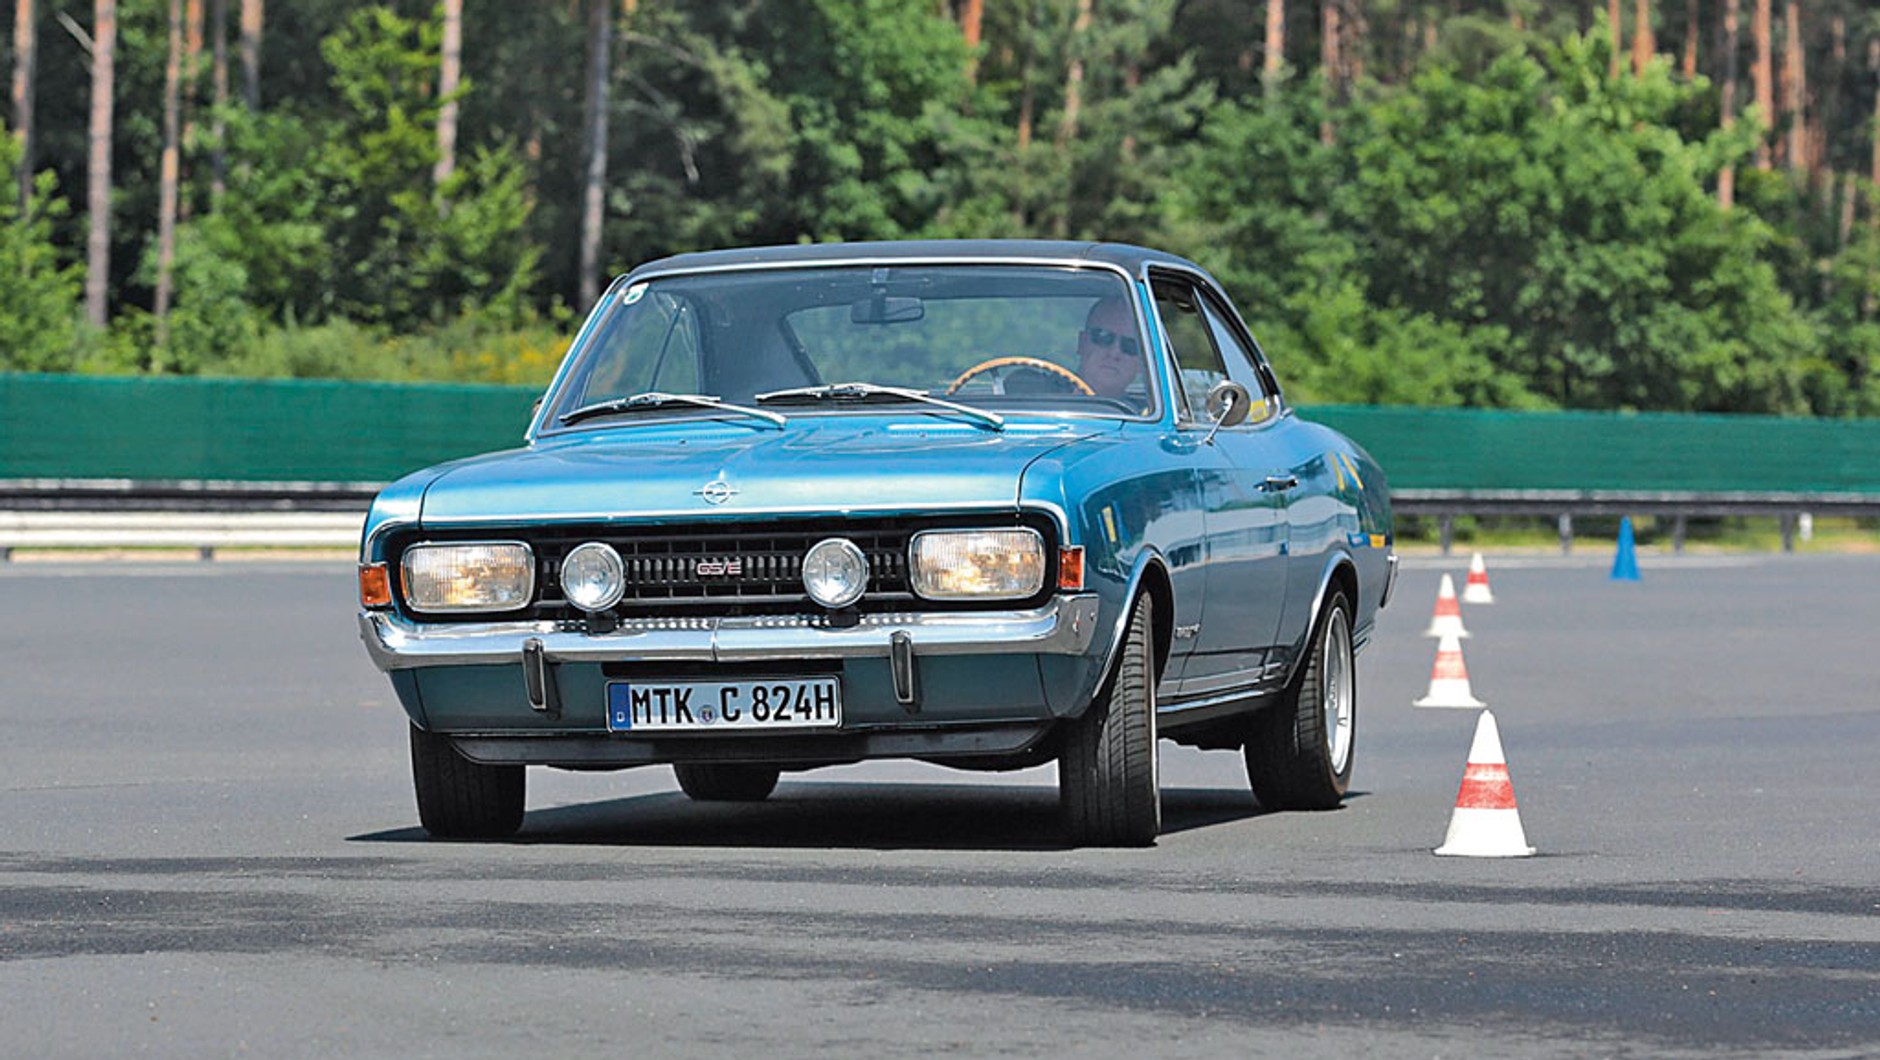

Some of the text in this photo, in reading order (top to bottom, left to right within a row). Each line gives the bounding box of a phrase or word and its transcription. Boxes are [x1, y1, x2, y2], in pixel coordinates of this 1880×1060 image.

[616, 711, 625, 722] D
[631, 684, 835, 724] MTK C 824H
